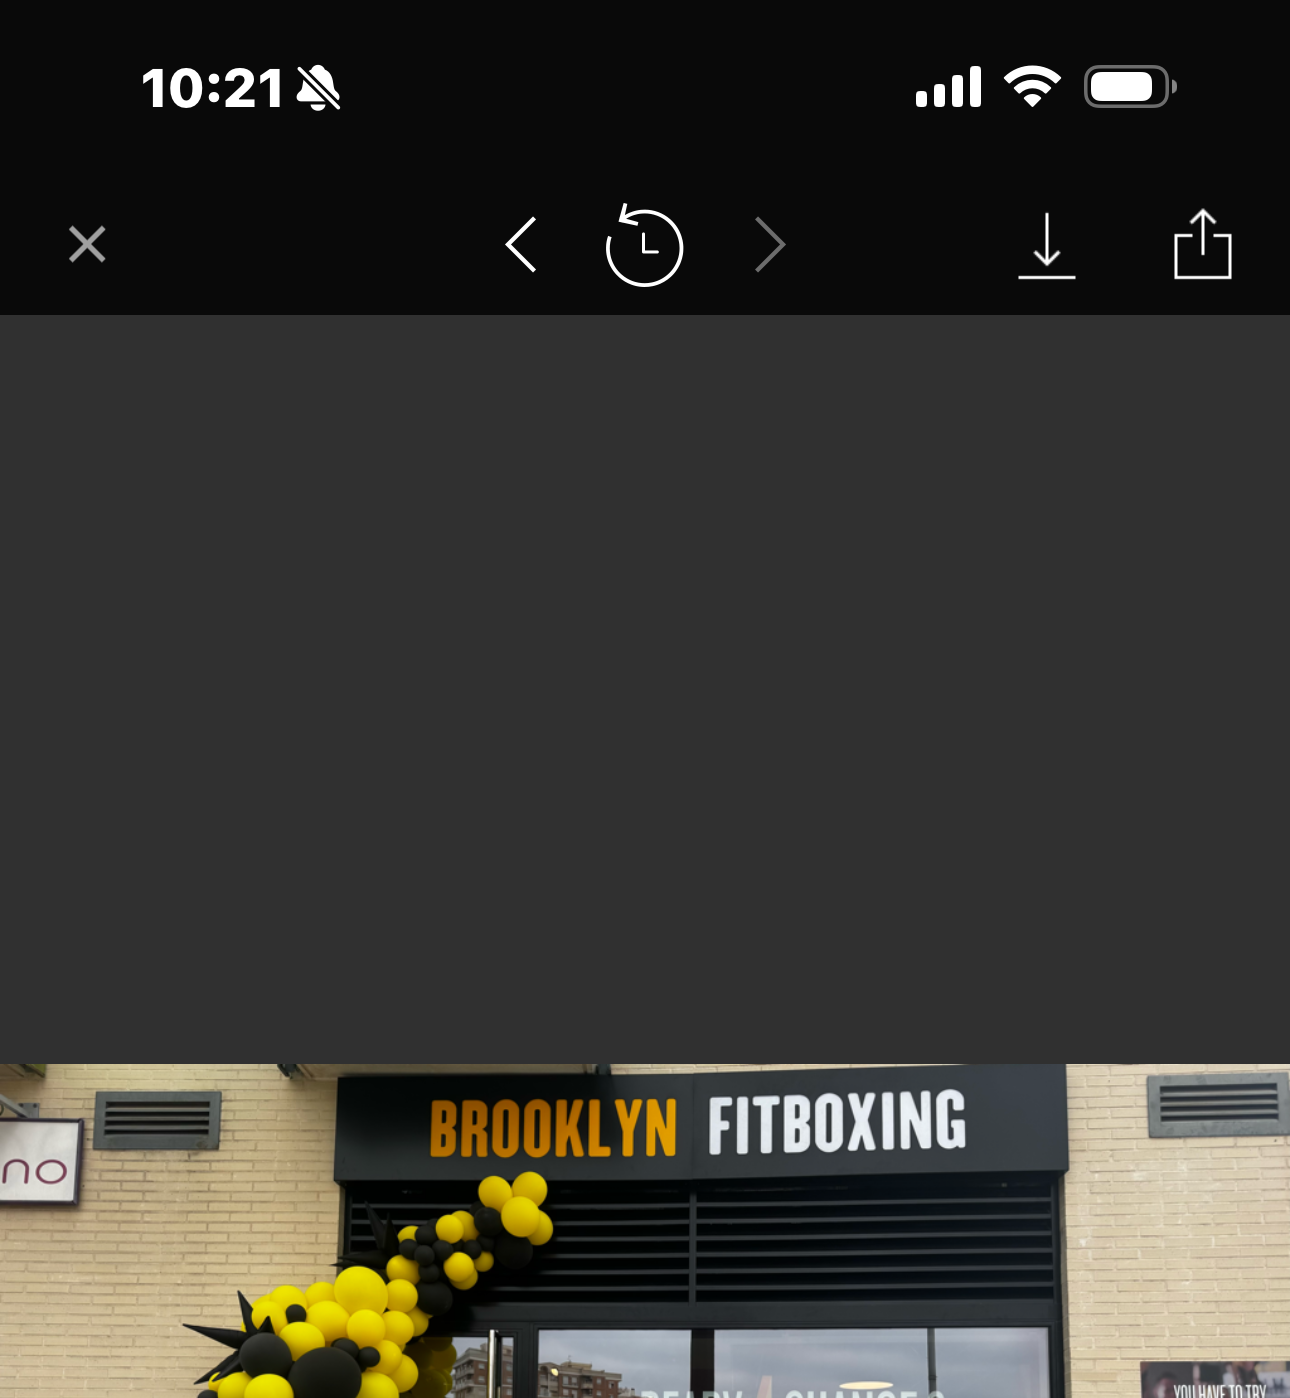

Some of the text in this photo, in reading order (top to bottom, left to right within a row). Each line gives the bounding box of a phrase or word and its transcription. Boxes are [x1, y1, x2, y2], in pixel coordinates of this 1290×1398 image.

[143, 68, 280, 108] 10:21
[430, 1089, 966, 1158] BROOKLYN FITBOXING
